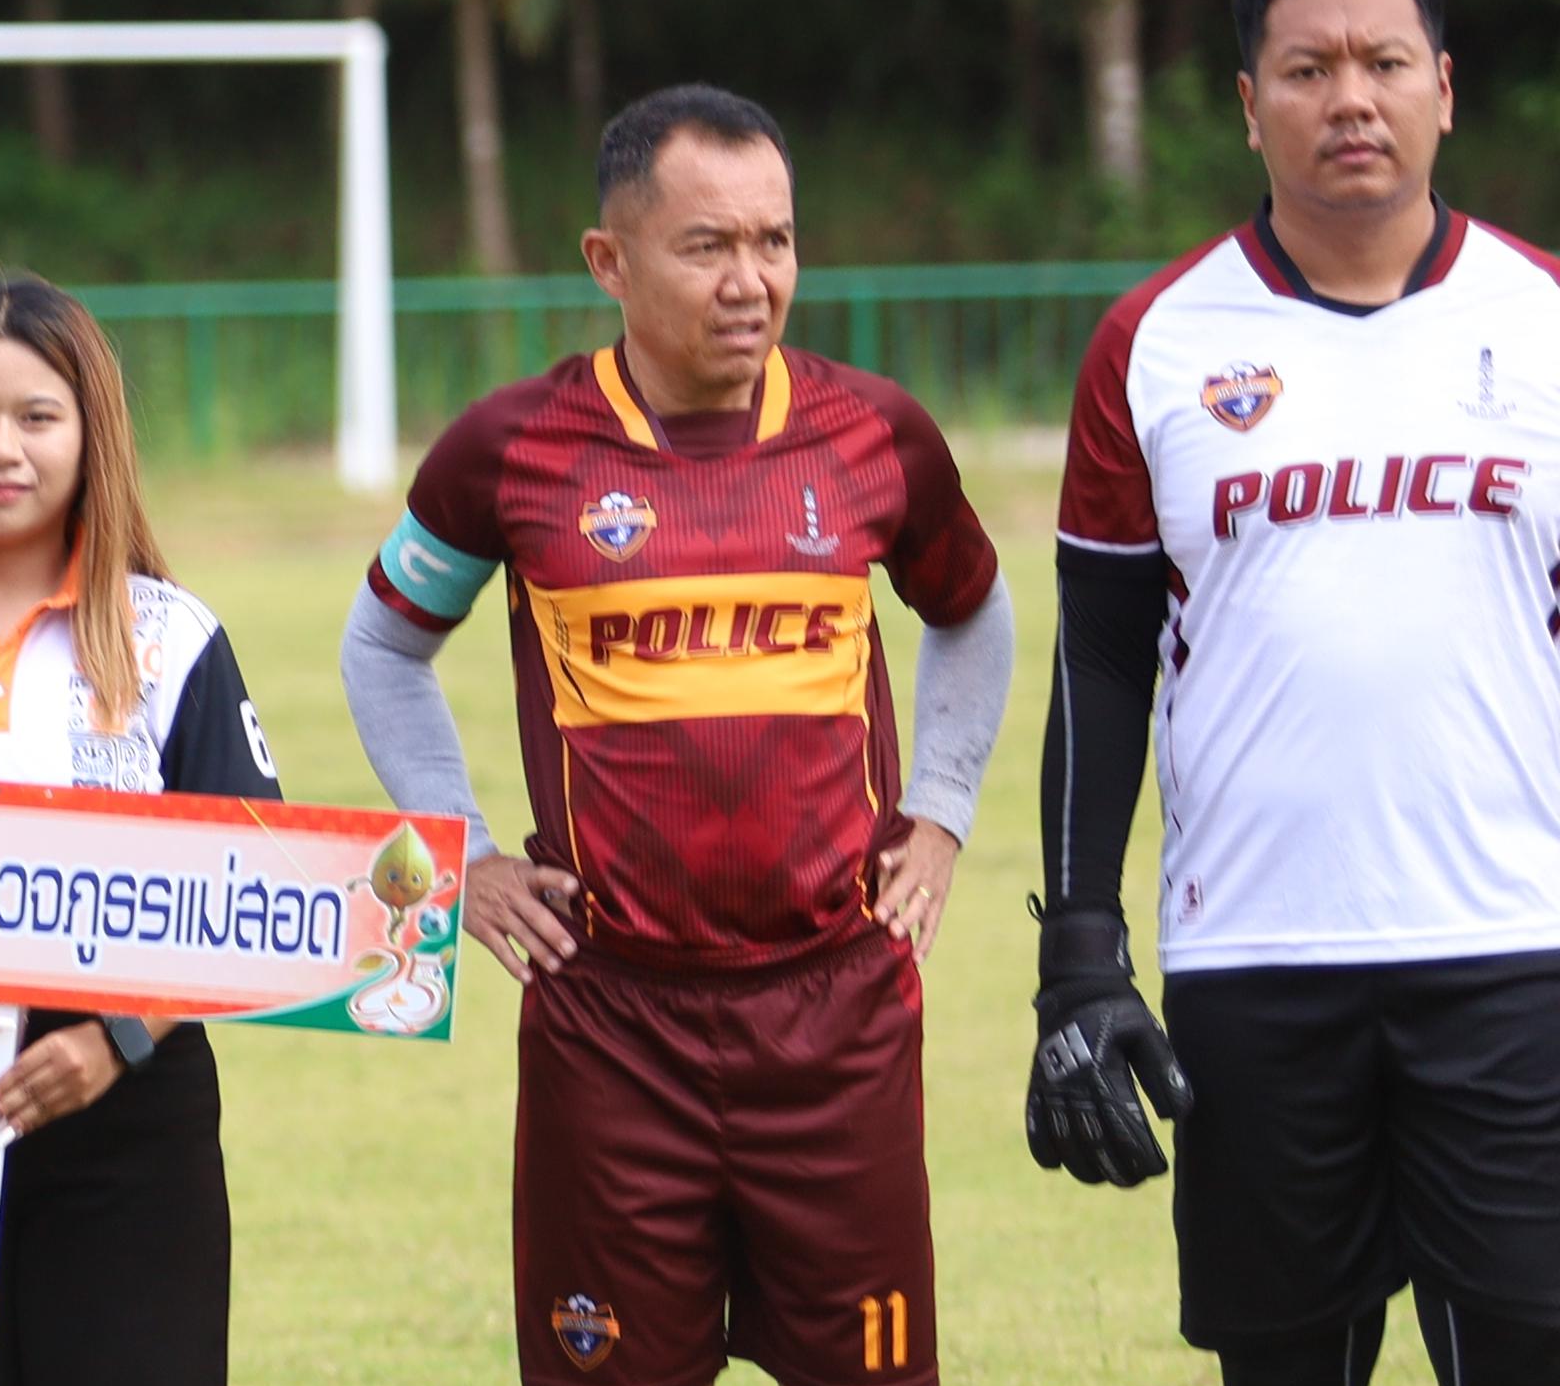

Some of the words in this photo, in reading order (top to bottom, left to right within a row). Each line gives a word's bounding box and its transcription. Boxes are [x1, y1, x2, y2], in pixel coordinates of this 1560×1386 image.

[1213, 454, 1532, 541] POLICE
[589, 602, 844, 666] POLICE
[858, 1289, 909, 1372] 11
